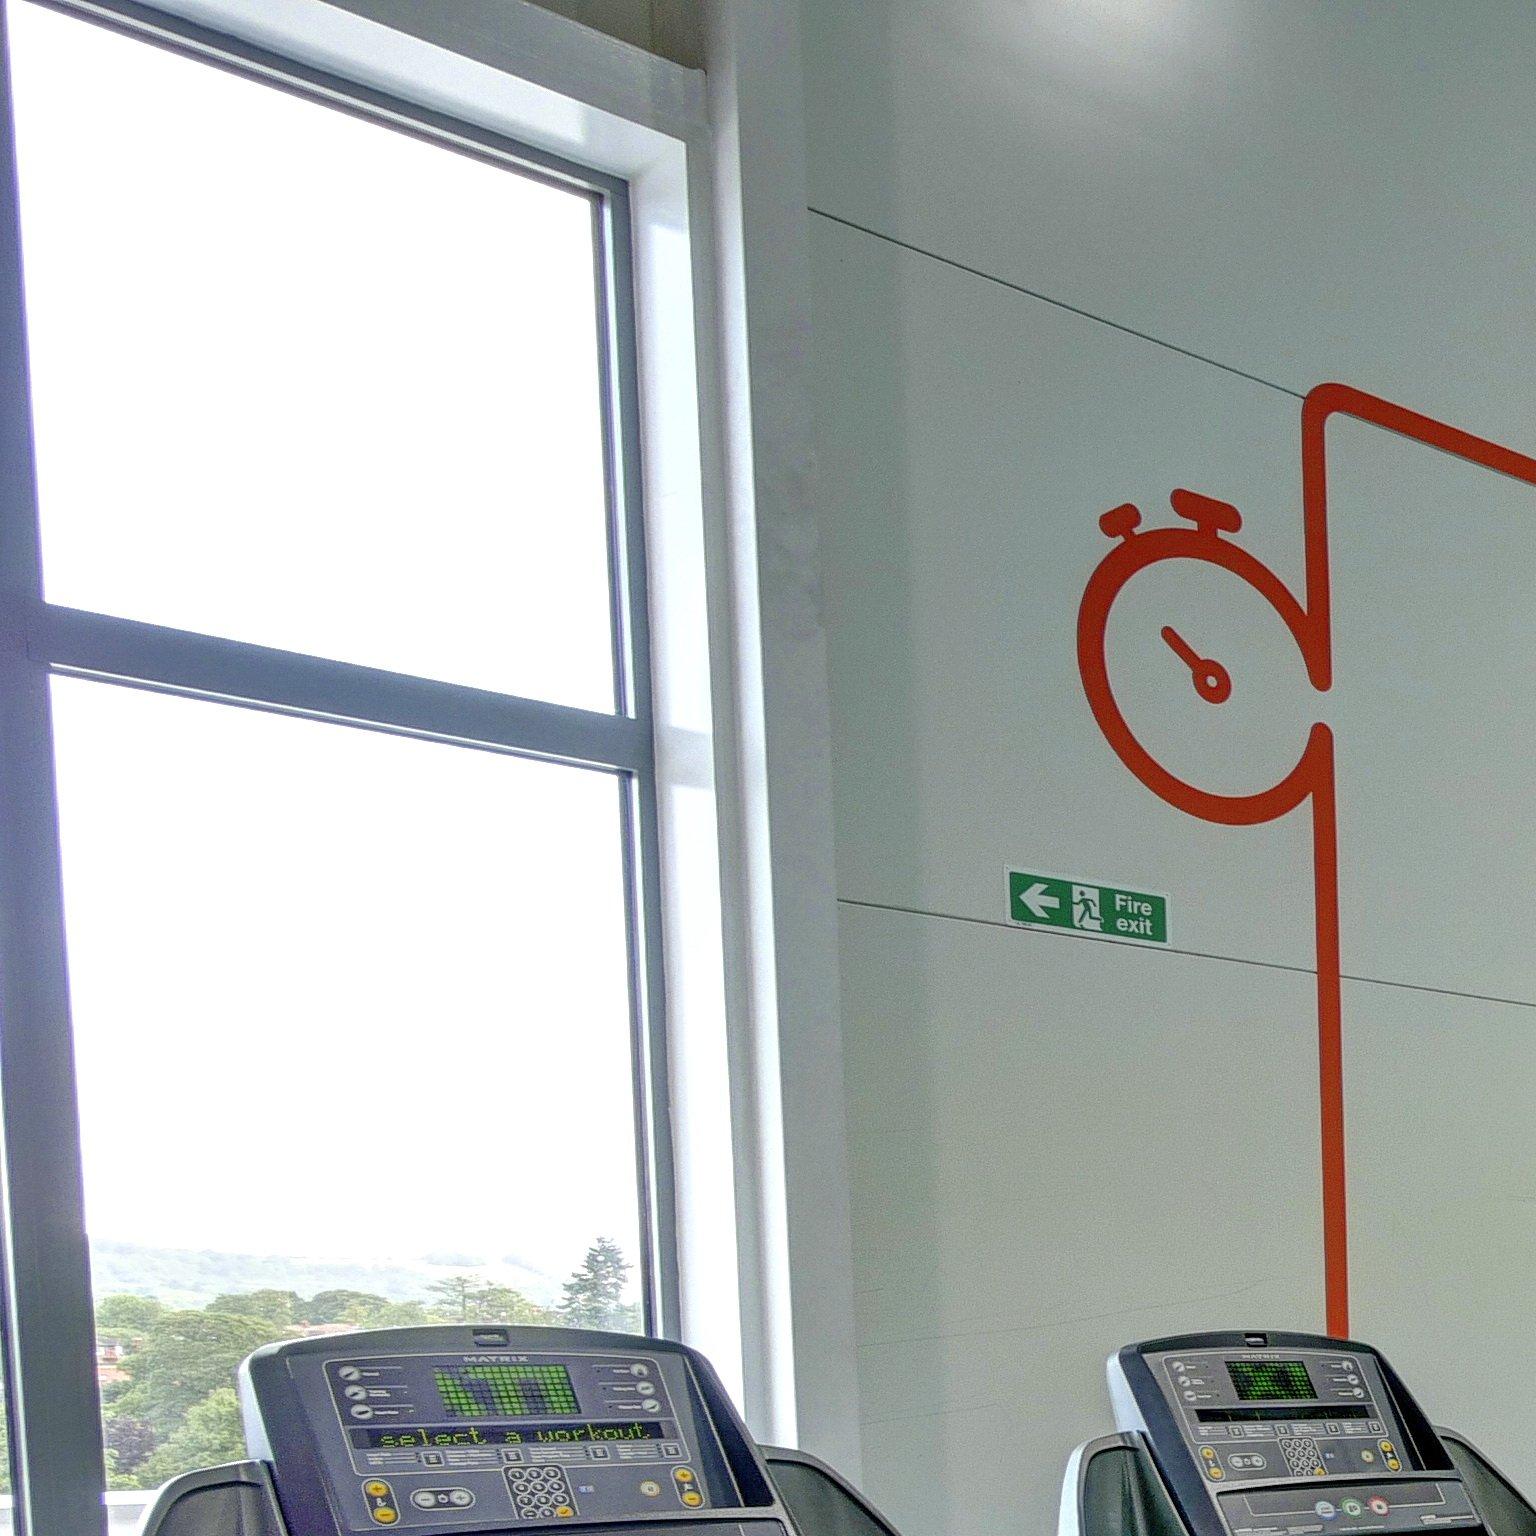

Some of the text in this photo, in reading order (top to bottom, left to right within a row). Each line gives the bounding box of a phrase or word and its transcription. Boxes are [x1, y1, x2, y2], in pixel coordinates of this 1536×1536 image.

[1114, 893, 1153, 916] Fire
[1116, 916, 1153, 936] exit
[463, 1355, 529, 1363] MATRIX
[379, 1421, 651, 1448] select a workout
